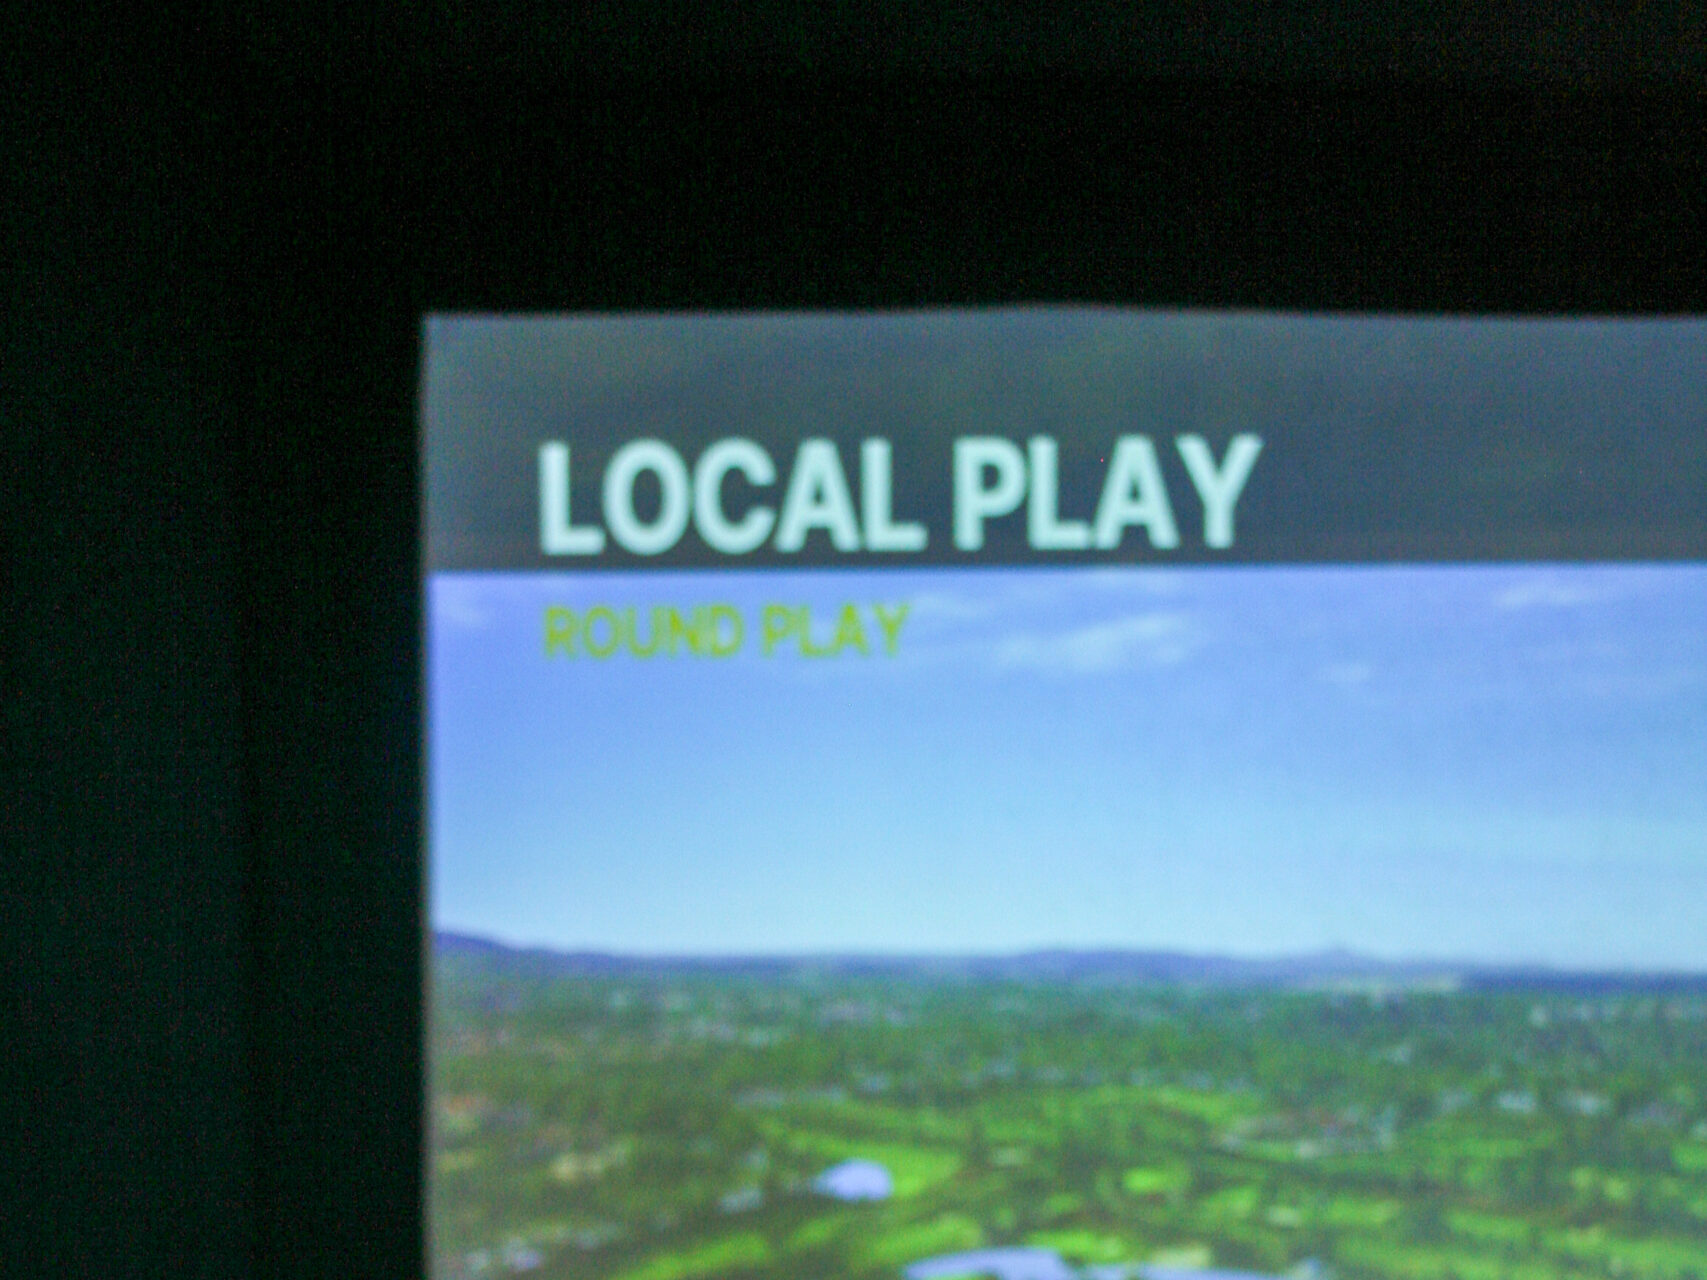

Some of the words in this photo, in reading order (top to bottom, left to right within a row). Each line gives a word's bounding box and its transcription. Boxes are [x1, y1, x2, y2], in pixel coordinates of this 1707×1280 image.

[539, 438, 928, 555] LOCAL
[953, 434, 1263, 551] PLAY
[544, 605, 744, 659] ROUND
[760, 602, 910, 657] PLAY
